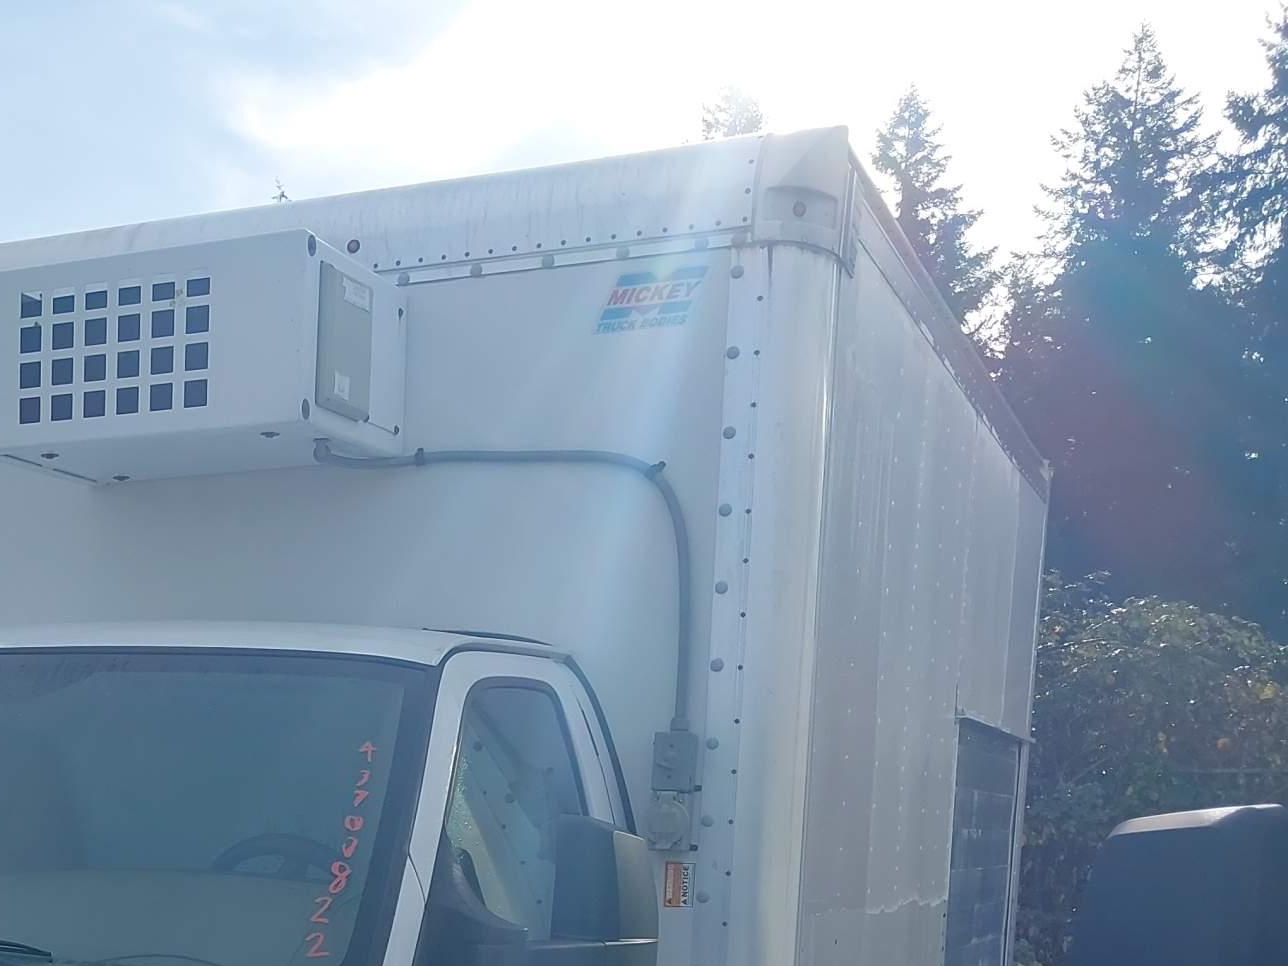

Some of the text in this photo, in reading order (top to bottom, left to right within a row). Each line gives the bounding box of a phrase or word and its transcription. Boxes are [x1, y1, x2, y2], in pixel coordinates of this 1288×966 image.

[607, 280, 701, 306] MICKEY
[595, 314, 688, 335] TRUCK BODIES
[681, 864, 689, 898] NOTICE
